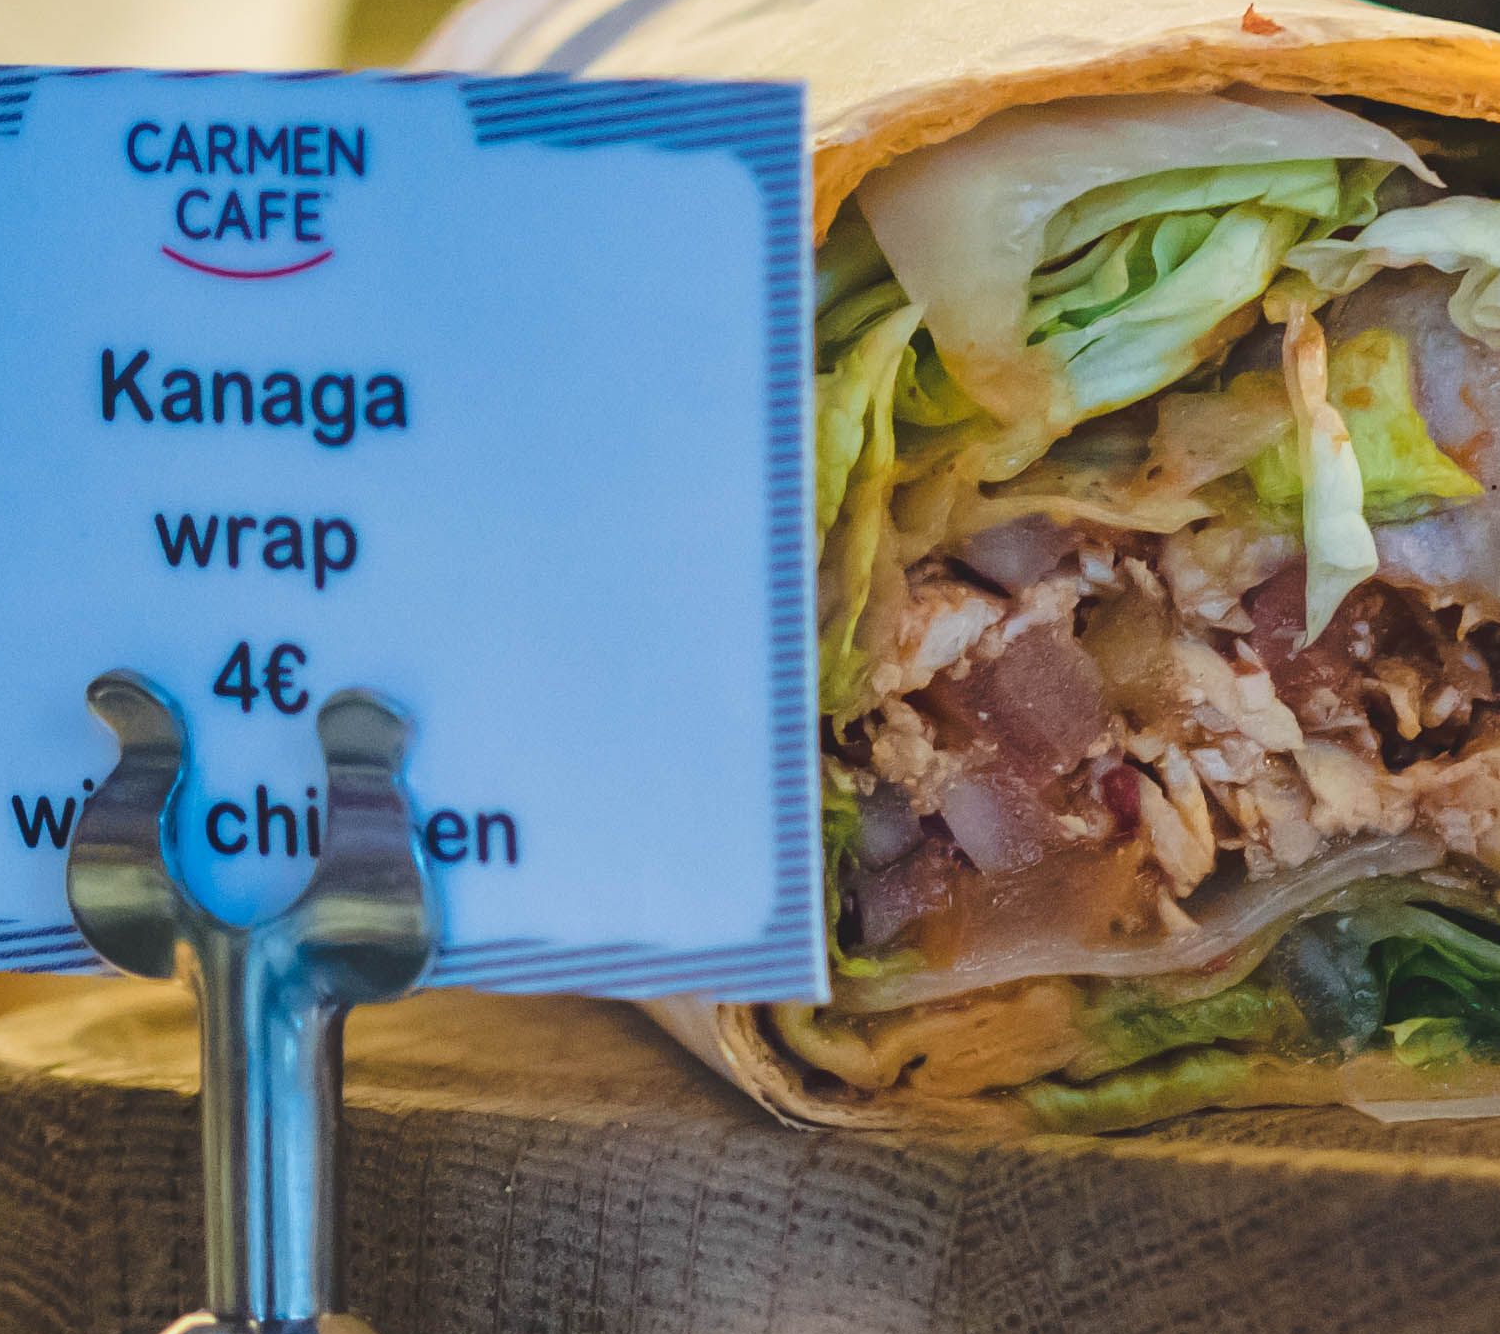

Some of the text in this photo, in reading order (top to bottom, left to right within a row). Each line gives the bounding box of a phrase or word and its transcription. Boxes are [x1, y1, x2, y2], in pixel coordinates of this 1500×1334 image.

[126, 122, 367, 178] CARMEN
[175, 188, 324, 243] CAFE
[101, 347, 408, 446] Kanaga
[154, 512, 358, 591] wrap
[212, 640, 310, 715] 4€
[204, 784, 520, 865] chien
